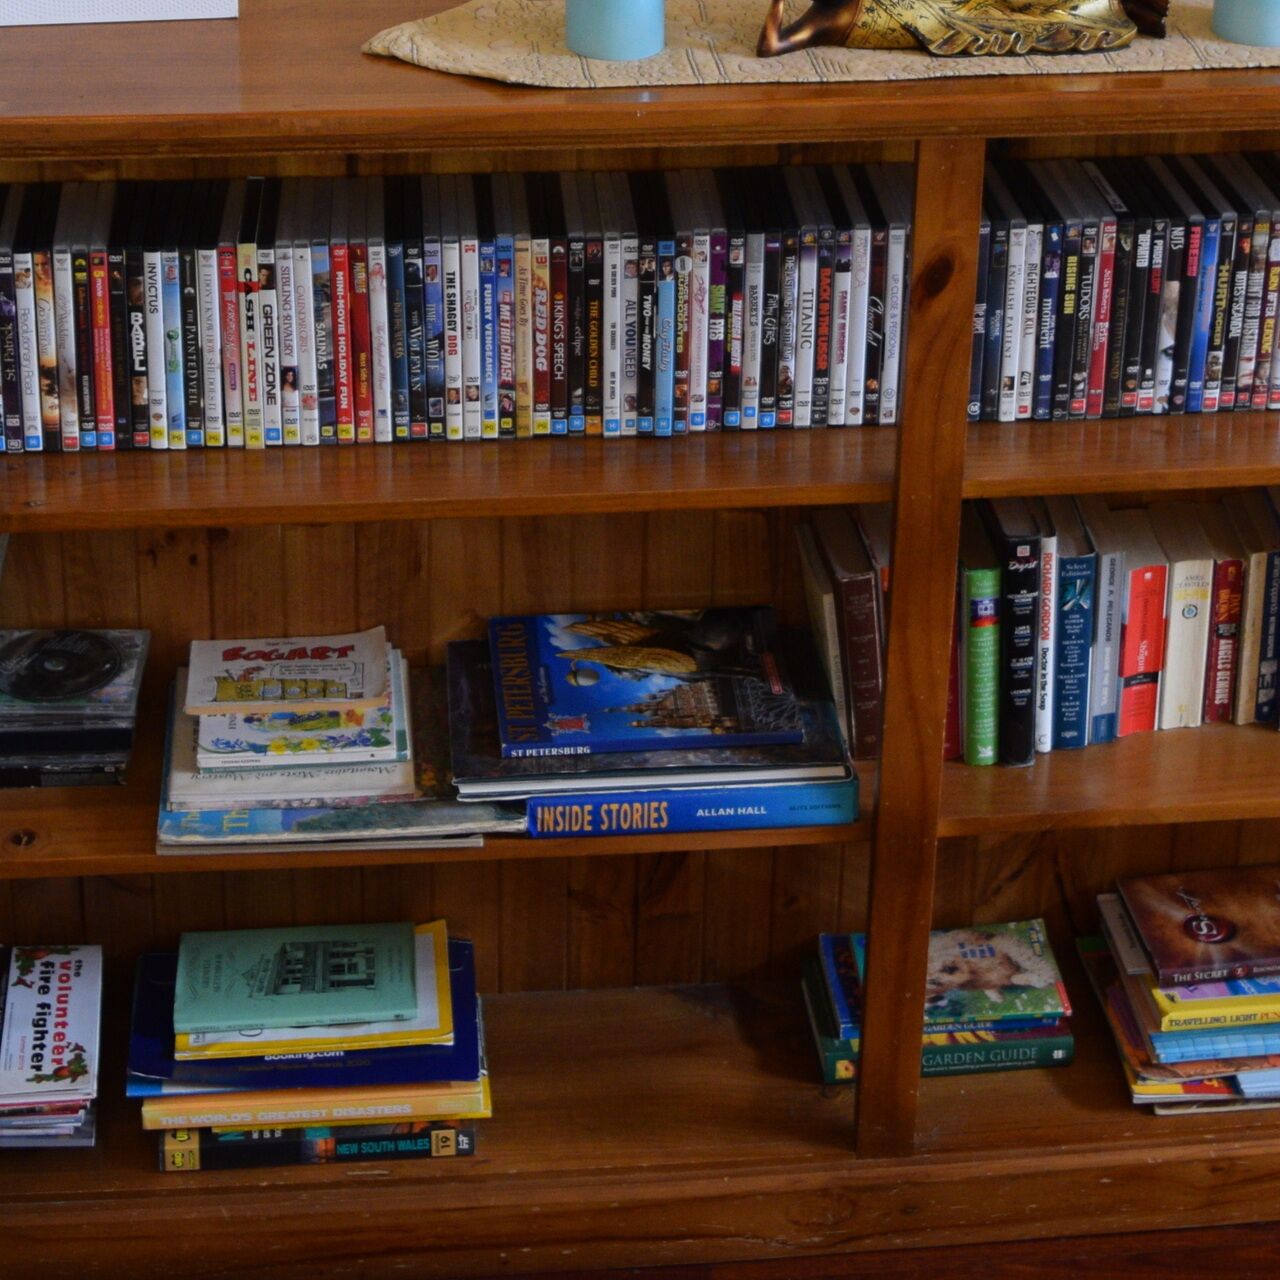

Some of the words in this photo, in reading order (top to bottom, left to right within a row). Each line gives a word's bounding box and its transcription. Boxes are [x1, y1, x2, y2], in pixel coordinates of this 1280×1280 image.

[1136, 233, 1149, 267] DEPARTED
[1171, 227, 1185, 250] NUTS
[147, 263, 158, 314] INVICTUS
[281, 266, 290, 310] SIBLING
[446, 272, 456, 289] THE
[1007, 264, 1016, 310] ENGLISH
[1025, 263, 1038, 314] RIGHTEOUS
[1065, 256, 1078, 291] RISING
[244, 268, 255, 332] CASH
[336, 271, 346, 334] MINI-MOVIE
[446, 293, 457, 332] SHAGGY
[483, 284, 492, 319] FURRY
[535, 288, 547, 329] RED
[589, 301, 598, 319] THE
[625, 301, 636, 320] ALL
[643, 294, 652, 317] TWO
[1063, 294, 1075, 314] SUN
[1078, 274, 1092, 320] TUDORS
[263, 304, 274, 358] GREEN
[554, 305, 564, 339] KING'S
[625, 321, 636, 346] YOU
[800, 289, 814, 349] TITANIC
[867, 296, 884, 347] Chocolat
[1023, 317, 1034, 338] KILL
[1040, 298, 1053, 349] moment
[4, 323, 16, 362] Patrick
[131, 312, 146, 371] BABEL
[185, 326, 198, 379] PAINTED
[315, 323, 327, 370] SALINAS
[448, 335, 457, 355] DOG
[484, 323, 493, 384] VENGEANCE
[535, 331, 548, 371] DOG
[589, 320, 598, 357] GOLDEN
[642, 333, 650, 370] MONEY
[1004, 316, 1014, 359] PATIENT
[7, 368, 16, 381] St.
[247, 342, 257, 402] LINE
[337, 336, 347, 384] HOLIDAY
[554, 342, 564, 380] SPEECH
[589, 360, 598, 387] CHILD
[625, 348, 636, 377] NEED
[188, 381, 198, 406] VEIL
[265, 362, 276, 405] ZONE
[340, 387, 348, 409] FUN
[1042, 553, 1052, 596] RICHARD
[1041, 600, 1052, 640] GORDON
[222, 644, 355, 661] BOGART
[1041, 647, 1049, 672] Doctor
[1217, 640, 1233, 669] ANGELS
[1039, 693, 1047, 710] Soup
[1040, 680, 1048, 691] the
[1214, 671, 1230, 704] DEMONS
[510, 748, 524, 757] ST
[526, 745, 591, 757] PETERSBURG
[536, 804, 594, 832] INSIDE
[600, 801, 669, 831] STORIES
[696, 806, 735, 818] ALLAN
[737, 805, 767, 816] HALL
[37, 960, 54, 996] fire
[73, 959, 83, 978] the
[1173, 974, 1192, 983] THE
[1194, 970, 1228, 980] SECRET
[30, 1003, 51, 1072] fighter
[1170, 1015, 1227, 1027] TRAVELLING
[1229, 1013, 1258, 1023] LIGHT
[923, 1051, 985, 1066] GARDEN
[990, 1048, 1039, 1061] GUIDE
[160, 1115, 186, 1125] THE
[190, 1112, 251, 1124] WORLD'S
[257, 1108, 328, 1121] GREATEST
[332, 1104, 412, 1117] DISASTERS
[336, 1142, 358, 1156] NEW
[361, 1140, 395, 1154] SOUTH
[397, 1138, 430, 1151] WALES
